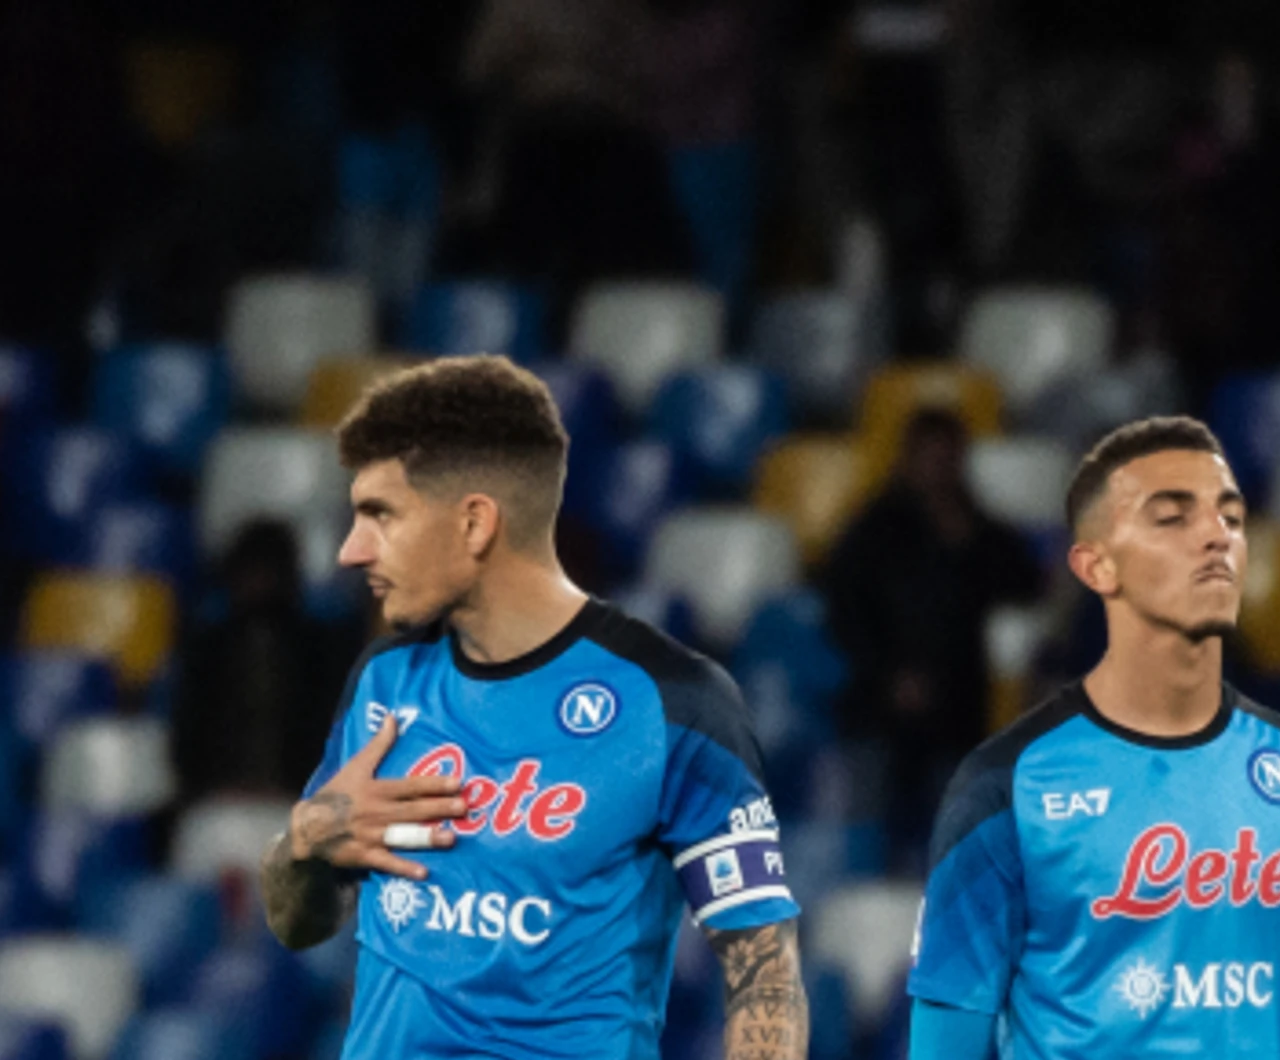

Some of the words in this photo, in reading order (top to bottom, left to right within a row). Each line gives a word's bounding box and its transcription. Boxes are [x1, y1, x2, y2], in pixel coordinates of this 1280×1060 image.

[366, 701, 419, 736] E7
[1041, 788, 1111, 820] EA7
[426, 885, 552, 945] MSC
[1173, 961, 1274, 1008] MSC
